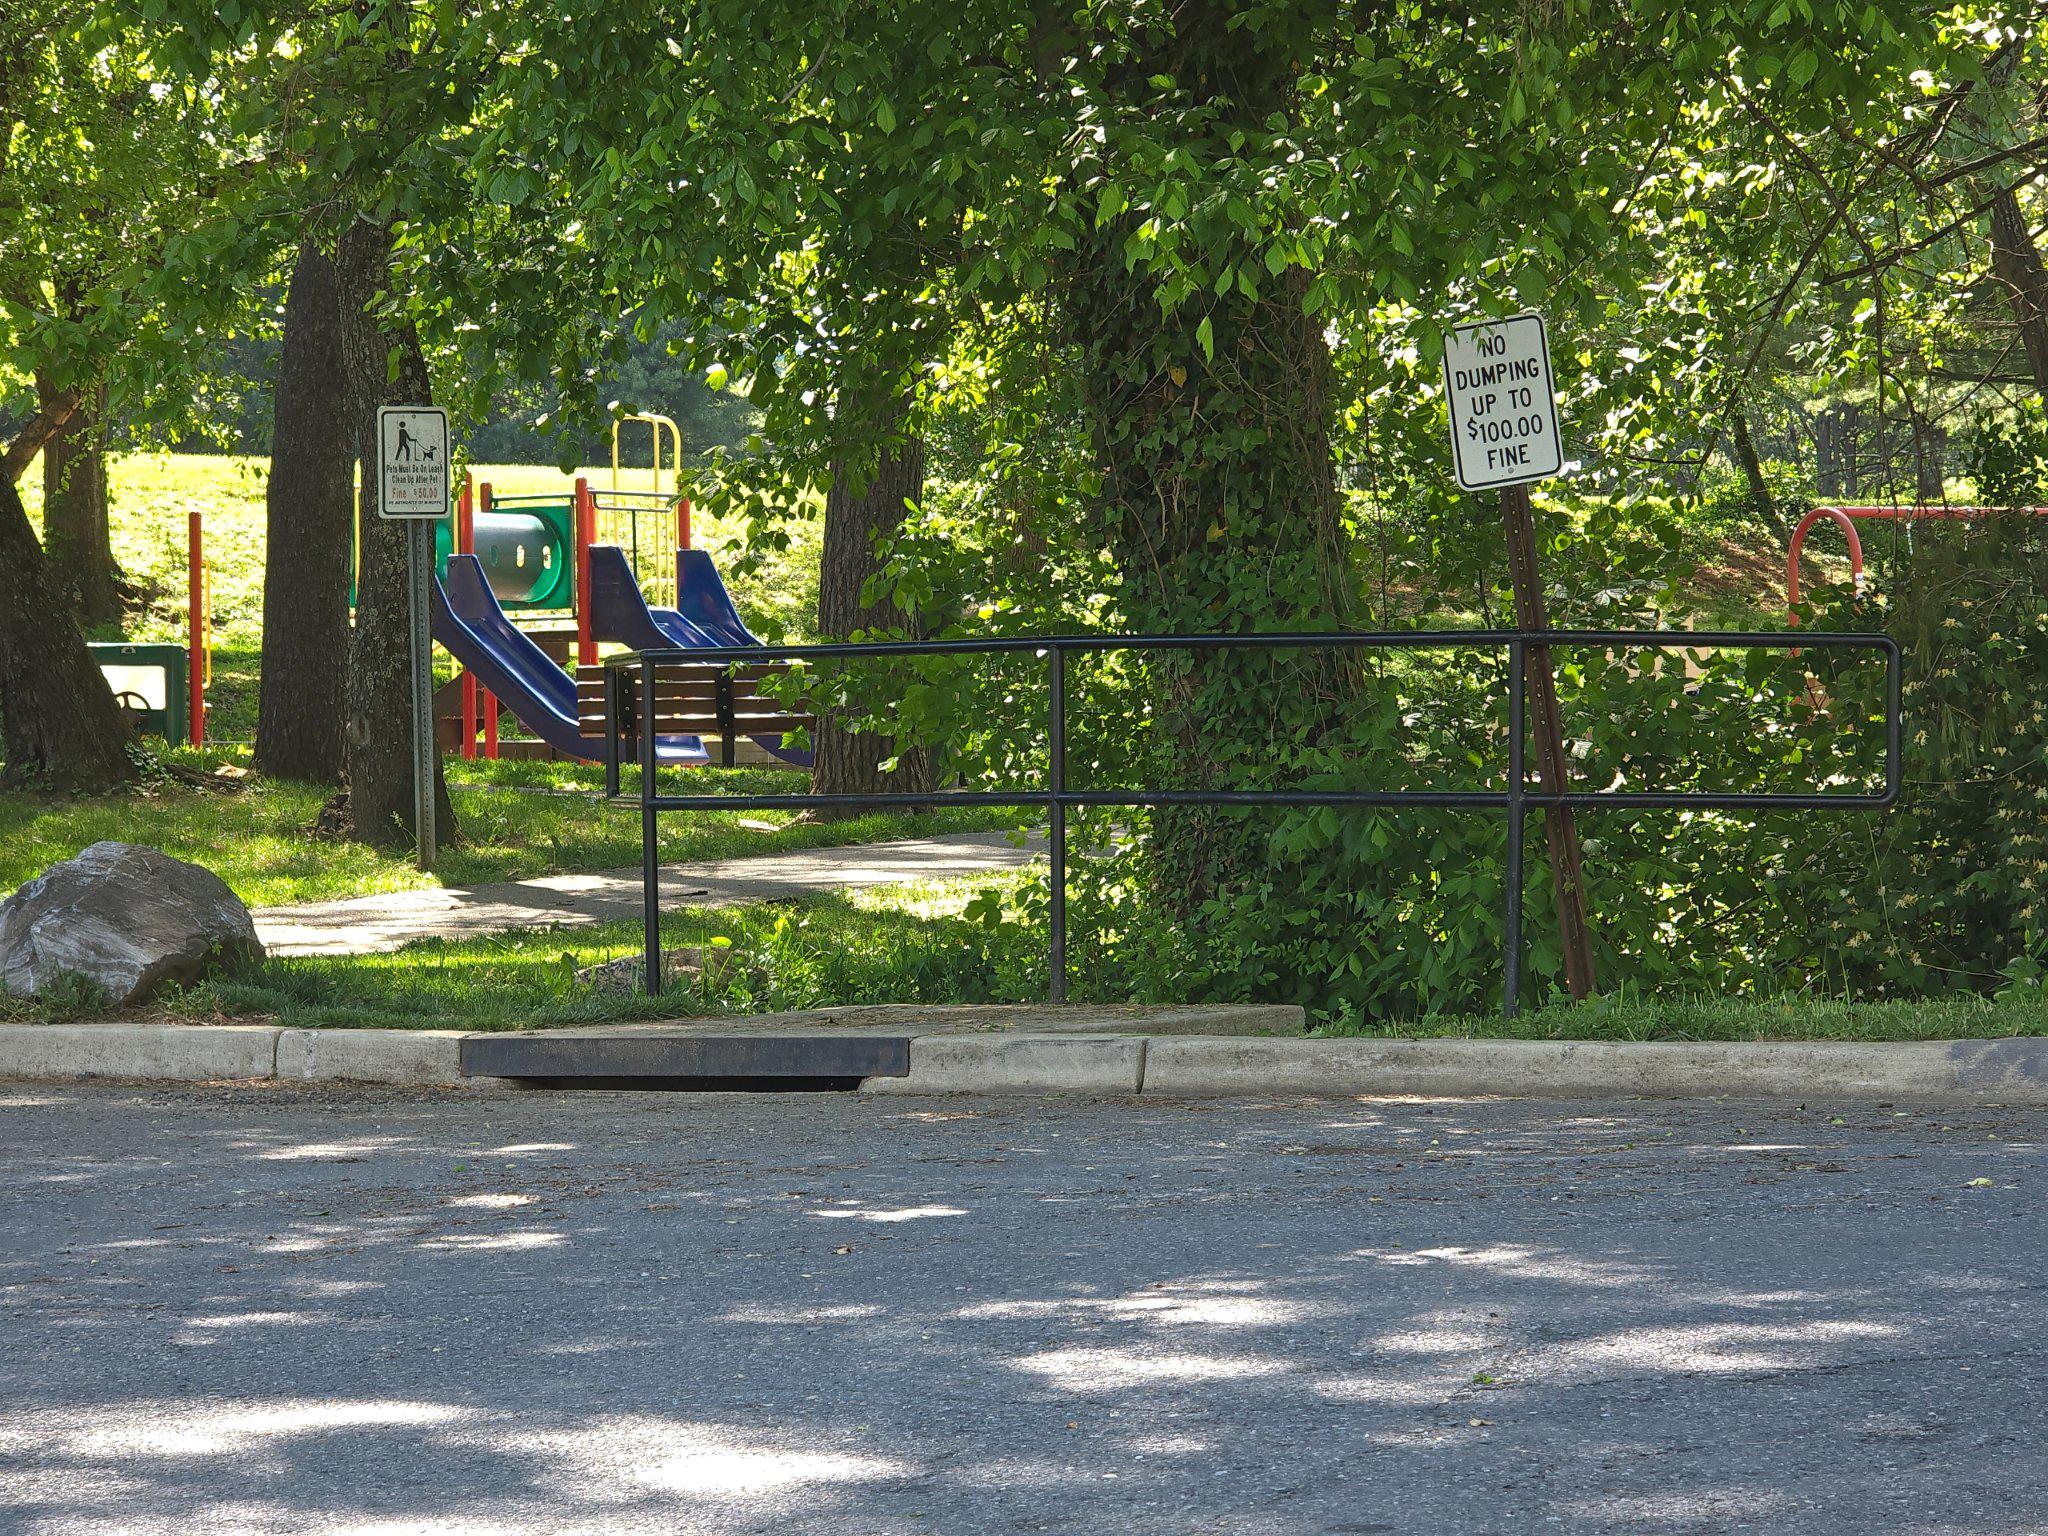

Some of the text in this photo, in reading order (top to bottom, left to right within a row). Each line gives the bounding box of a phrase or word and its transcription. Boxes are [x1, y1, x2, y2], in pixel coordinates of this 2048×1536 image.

[1480, 335, 1506, 358] NO
[1455, 358, 1539, 391] DUMPING
[1471, 387, 1532, 416] UP TO
[1467, 414, 1543, 443] $100.00
[386, 464, 443, 473] Pets Must Be On Leash
[1487, 444, 1530, 470] FINE
[392, 474, 438, 485] Clean Up After Pet
[392, 487, 438, 499] Fine $50.00
